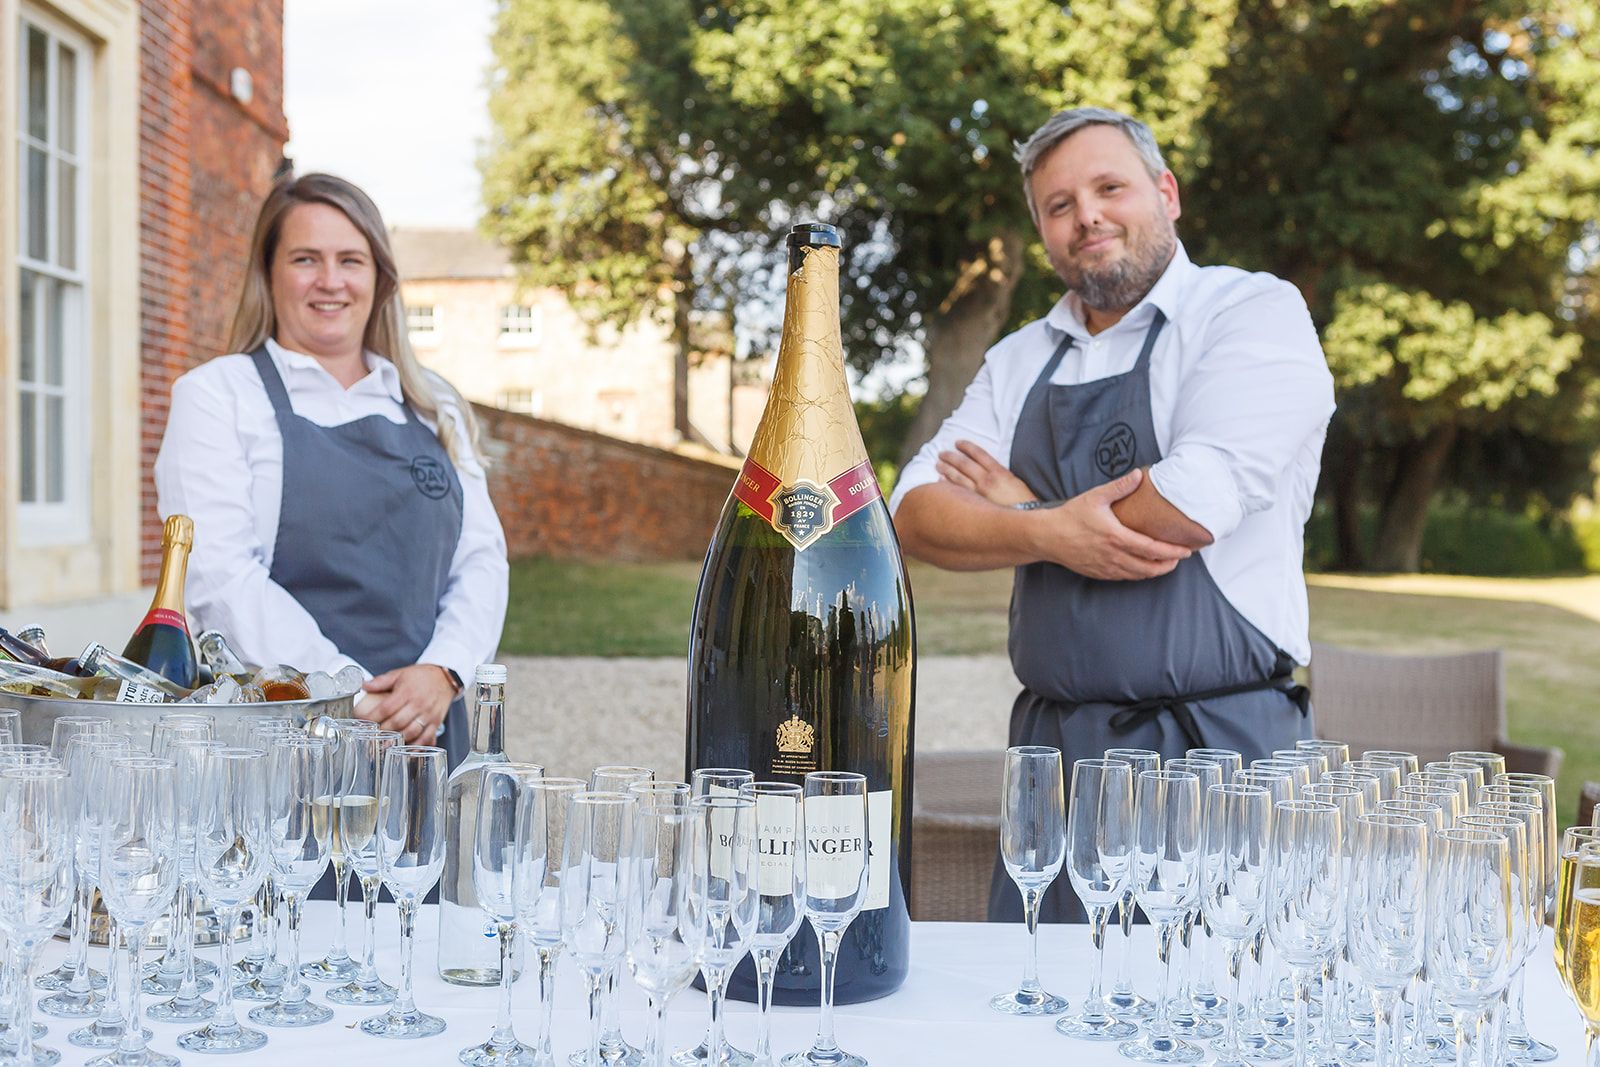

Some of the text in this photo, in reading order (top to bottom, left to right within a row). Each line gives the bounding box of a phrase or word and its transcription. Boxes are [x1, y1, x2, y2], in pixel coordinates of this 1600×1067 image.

[1099, 434, 1132, 466] DAY
[414, 464, 446, 484] DAY
[740, 473, 761, 492] NGER
[783, 494, 824, 506] BOLLINGER
[791, 510, 815, 520] 1829
